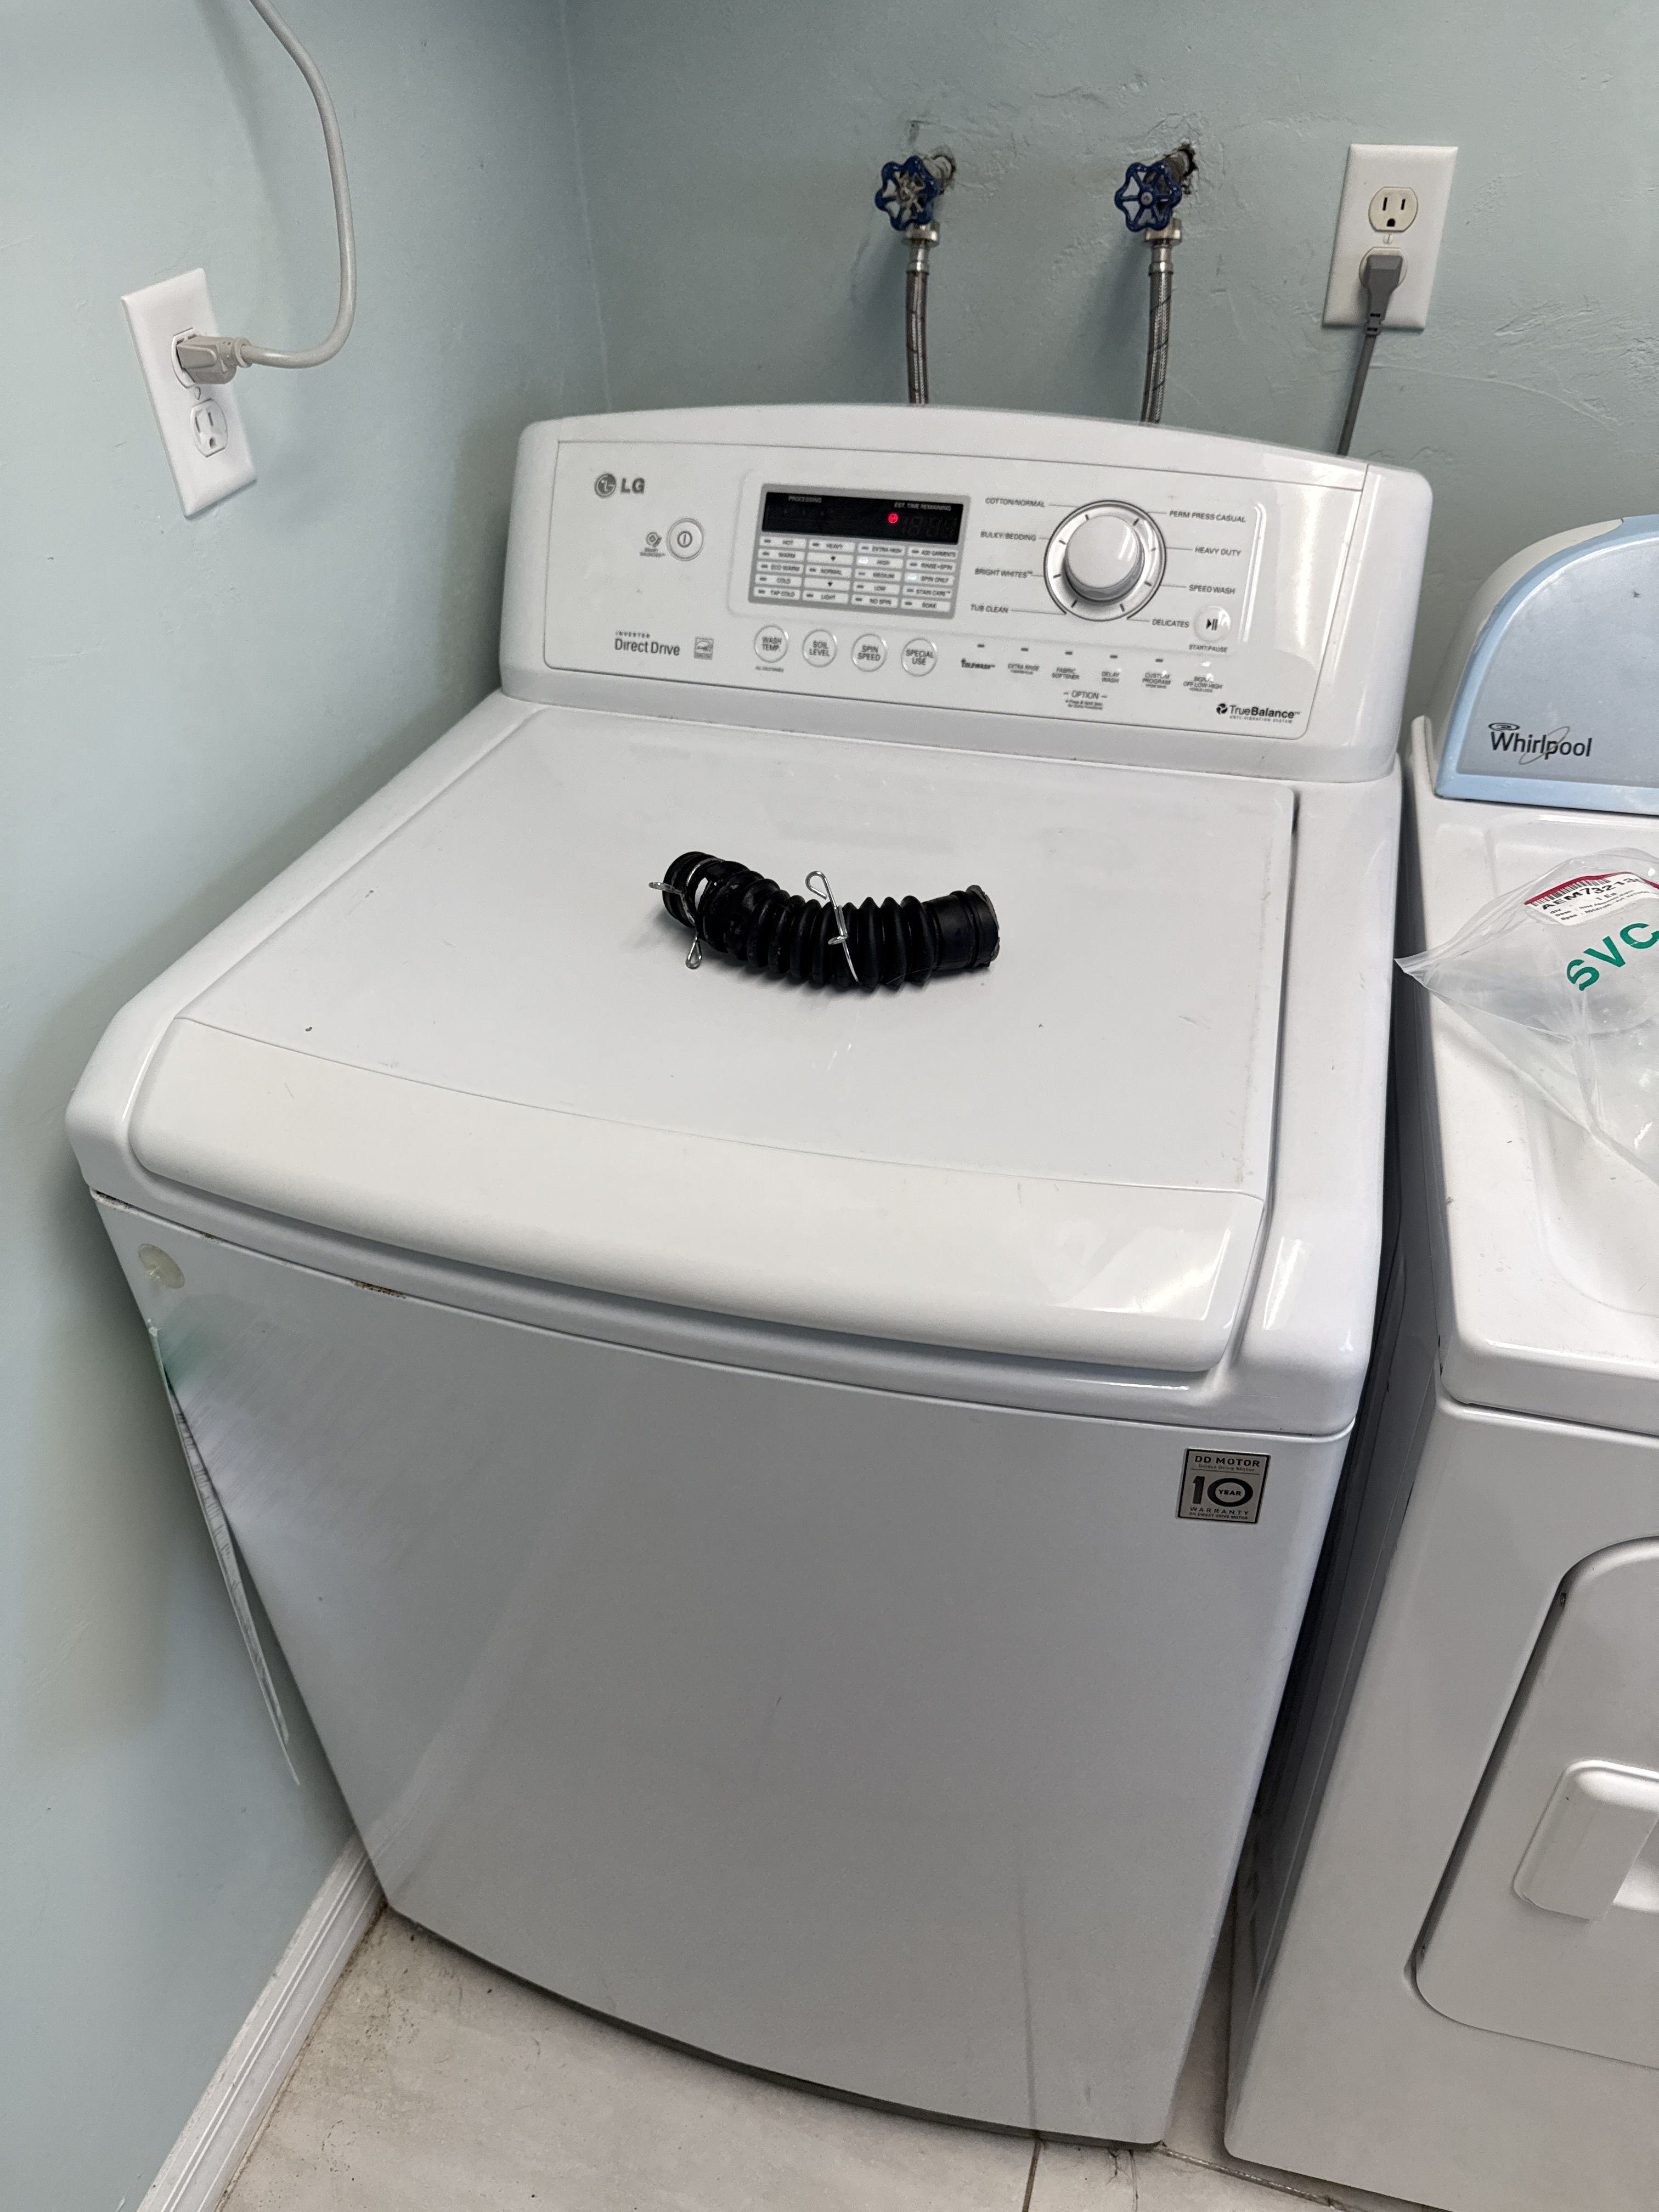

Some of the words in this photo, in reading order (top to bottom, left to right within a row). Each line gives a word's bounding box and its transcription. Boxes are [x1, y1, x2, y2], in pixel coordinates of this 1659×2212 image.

[620, 477, 646, 494] LG
[788, 495, 822, 504] PROCESSING
[1216, 514, 1246, 523] CASUAL
[980, 531, 1036, 541] BULKY/BEDDING
[975, 568, 1000, 576] BRIGHT
[1214, 586, 1236, 594] WASH
[985, 605, 1009, 613] CLEAN
[1152, 619, 1189, 628] DELICATES
[762, 636, 782, 645] WASH
[812, 641, 828, 649] SOIL
[614, 638, 648, 653] Direct
[651, 642, 680, 656] Drive
[862, 644, 879, 653] SPIN
[809, 648, 830, 657] LEVEL
[857, 652, 881, 662] SPEED
[905, 650, 934, 658] SPECIAL
[912, 657, 927, 665] USE
[1071, 691, 1099, 699] OPTION
[1490, 731, 1593, 759] Whirlpool
[1566, 922, 1659, 991] SVC
[1216, 1457, 1260, 1468] MOTOR
[1192, 1476, 1253, 1507] 10
[1190, 1506, 1249, 1515] WARRANTY
